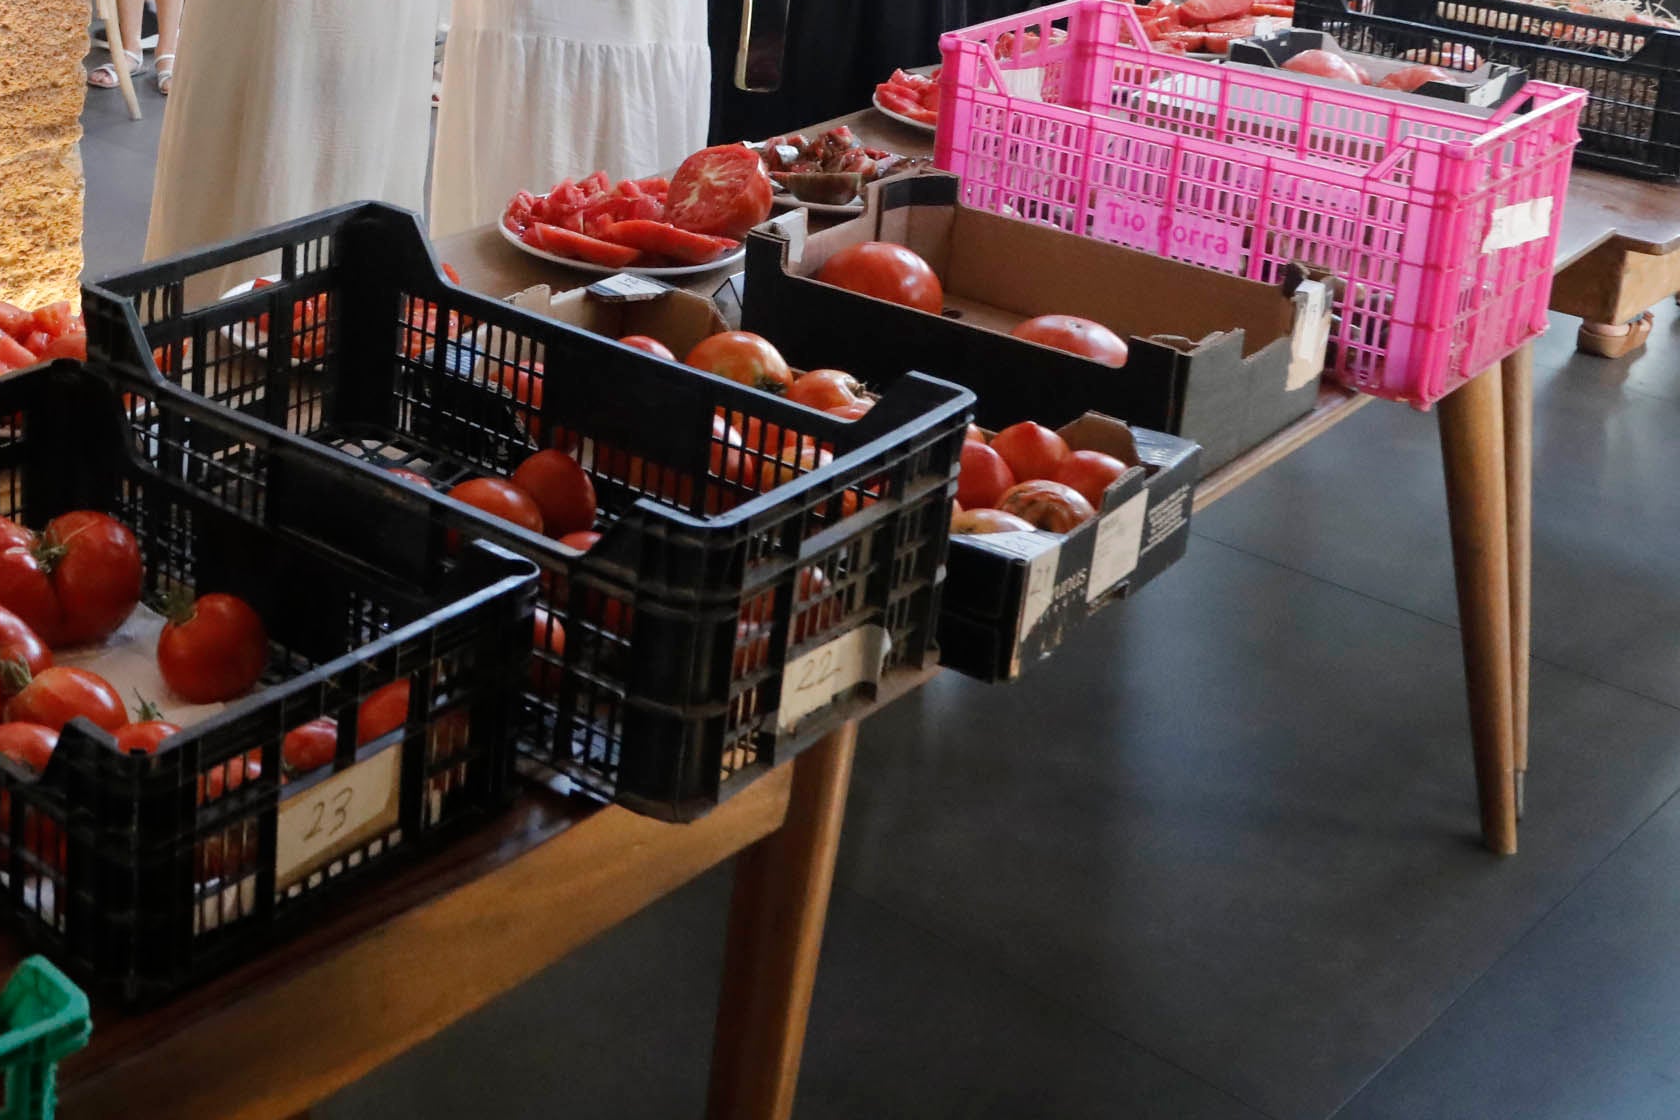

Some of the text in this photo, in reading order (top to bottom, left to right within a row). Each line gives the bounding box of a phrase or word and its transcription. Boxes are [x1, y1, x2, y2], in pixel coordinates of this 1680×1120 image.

[1106, 201, 1229, 255] Tio Porra
[795, 650, 842, 692] 22
[303, 786, 354, 840] 23
